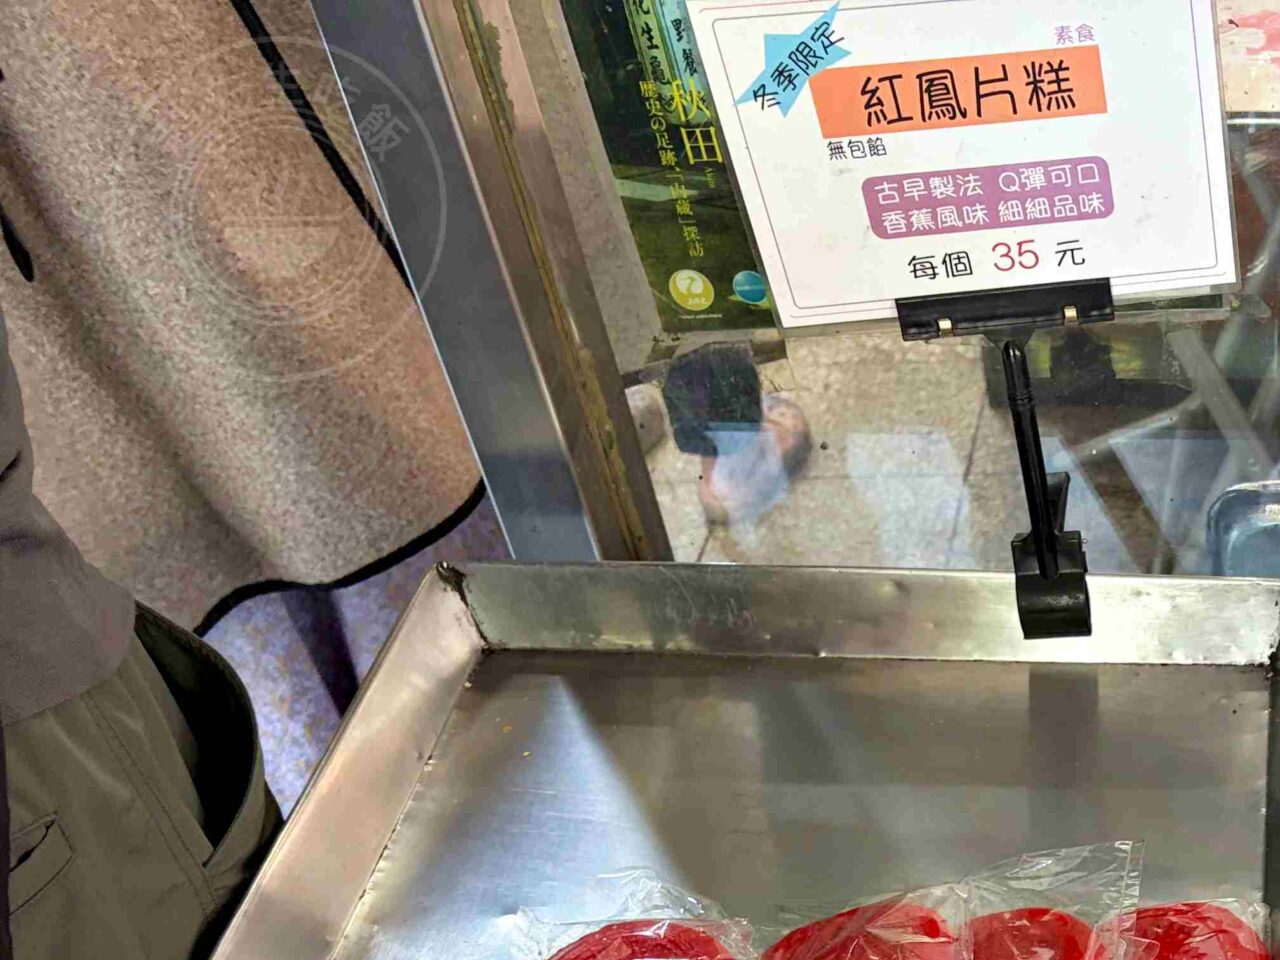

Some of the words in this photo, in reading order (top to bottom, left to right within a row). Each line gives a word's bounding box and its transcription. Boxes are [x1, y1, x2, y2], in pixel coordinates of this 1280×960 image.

[1054, 24, 1096, 44] 素食
[752, 20, 844, 111] 冬季限定
[860, 60, 1077, 128] 紅鳳片糕
[667, 78, 723, 166] 秋田
[826, 138, 888, 161] 無包餡
[875, 174, 983, 204] 古早製法
[999, 163, 1101, 191] Q彈可口
[882, 204, 989, 235] 香蕉風味
[998, 193, 1106, 222] 細細品味
[908, 250, 974, 280] 每個
[991, 240, 1040, 272] 35
[1055, 240, 1086, 267] 元
